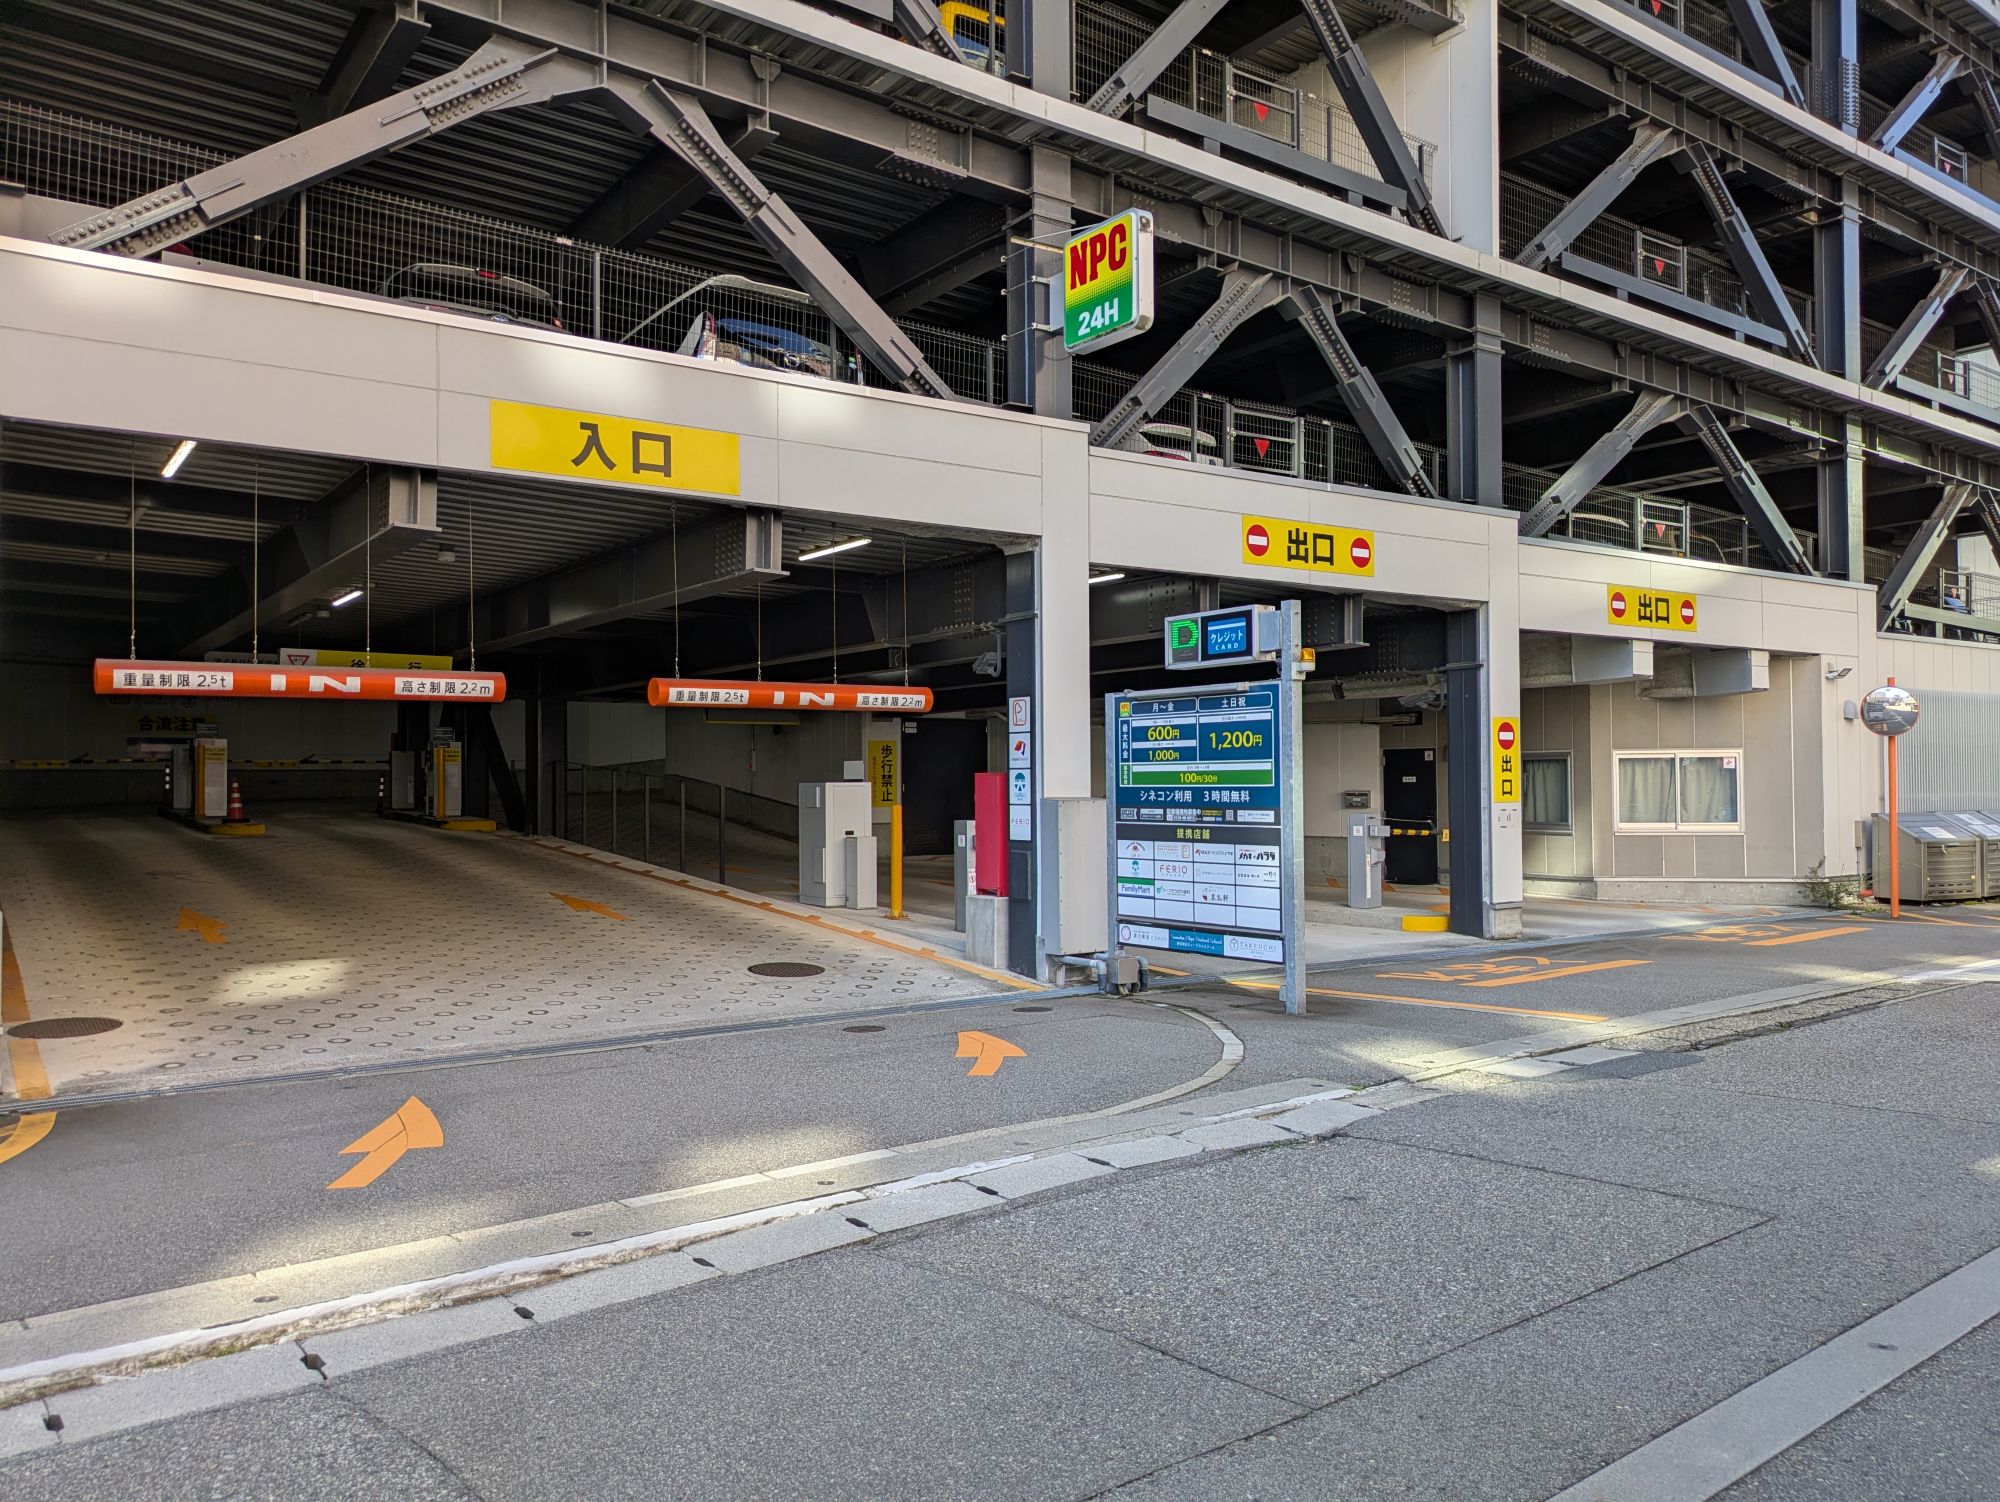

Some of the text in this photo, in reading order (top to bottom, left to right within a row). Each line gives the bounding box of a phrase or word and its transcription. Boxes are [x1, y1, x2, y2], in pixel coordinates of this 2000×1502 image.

[1069, 222, 1127, 292] NPC
[1077, 298, 1119, 337] 24H
[570, 421, 672, 478] 入口
[1287, 526, 1336, 567] 出口
[1637, 593, 1670, 624] 出口
[1210, 629, 1243, 644] クレジット
[1215, 642, 1239, 651] CARD
[123, 672, 227, 689] 重量制限 2.5t
[270, 674, 361, 693] IN
[401, 679, 491, 696] 高さ制限 2.2m
[674, 690, 721, 703] 重量制限
[773, 691, 835, 706] IN
[861, 695, 900, 708] 高さ制限
[1221, 696, 1246, 708] 土日祝
[1147, 726, 1180, 741] 600円
[1209, 730, 1262, 751] 1,200円
[1148, 750, 1180, 762] 1,000円
[881, 744, 894, 802] 歩行禁止
[1179, 773, 1218, 783] 100円/30分
[1500, 754, 1513, 797] 出口
[1139, 790, 1250, 803] シネコン利用 3時間無料
[1176, 828, 1211, 840] 提携店舗
[1159, 864, 1188, 874] FERIO
[1121, 885, 1151, 895] FamilyMart
